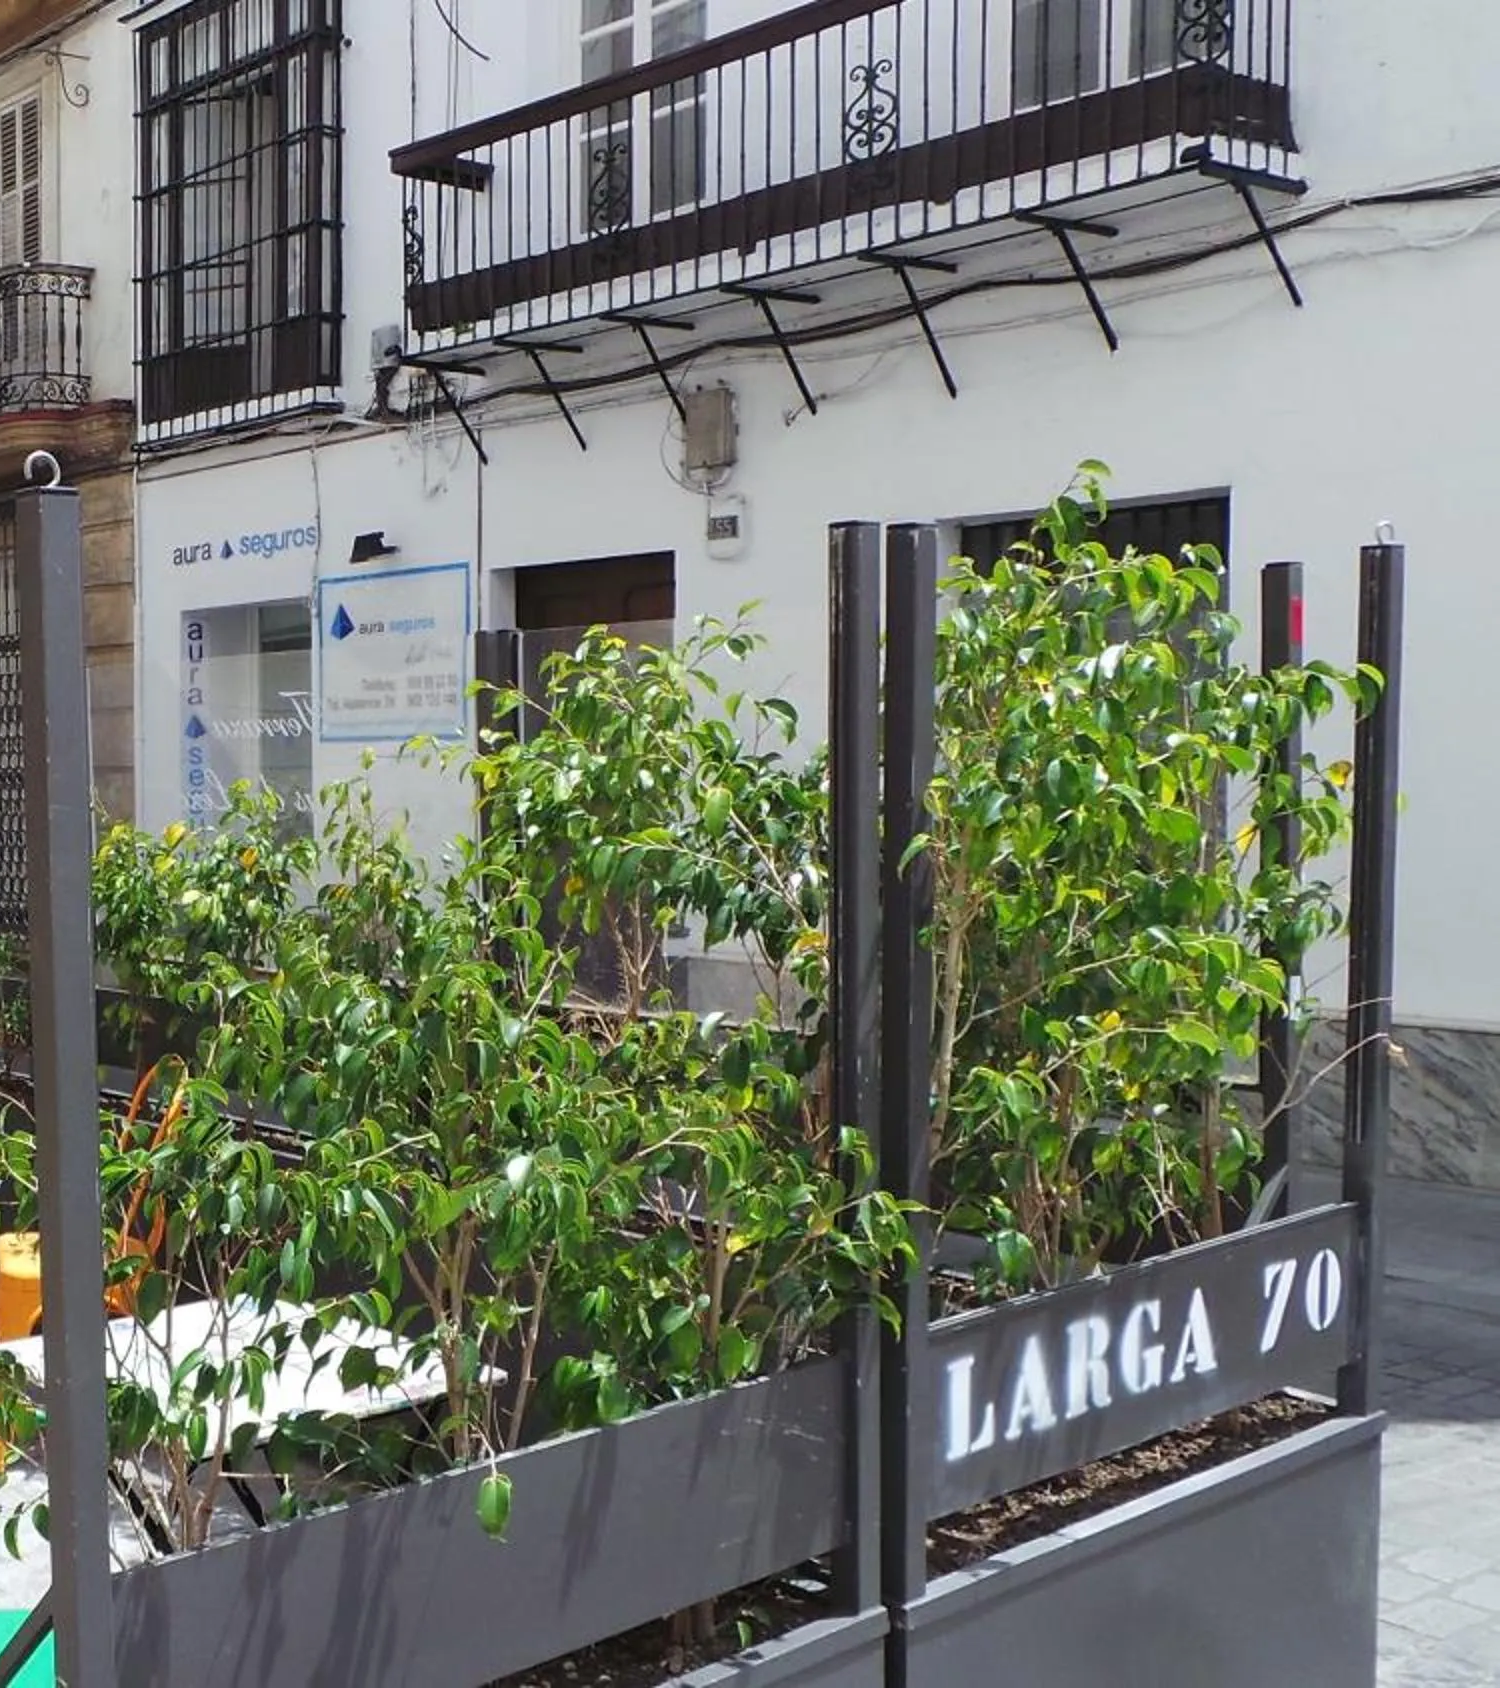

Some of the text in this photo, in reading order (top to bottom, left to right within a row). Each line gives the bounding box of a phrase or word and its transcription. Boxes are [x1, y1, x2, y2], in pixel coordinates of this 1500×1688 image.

[173, 525, 316, 566] aura seguros
[359, 616, 436, 635] aura seguros
[187, 622, 203, 705] aura
[946, 1248, 1342, 1462] LARGA 70
